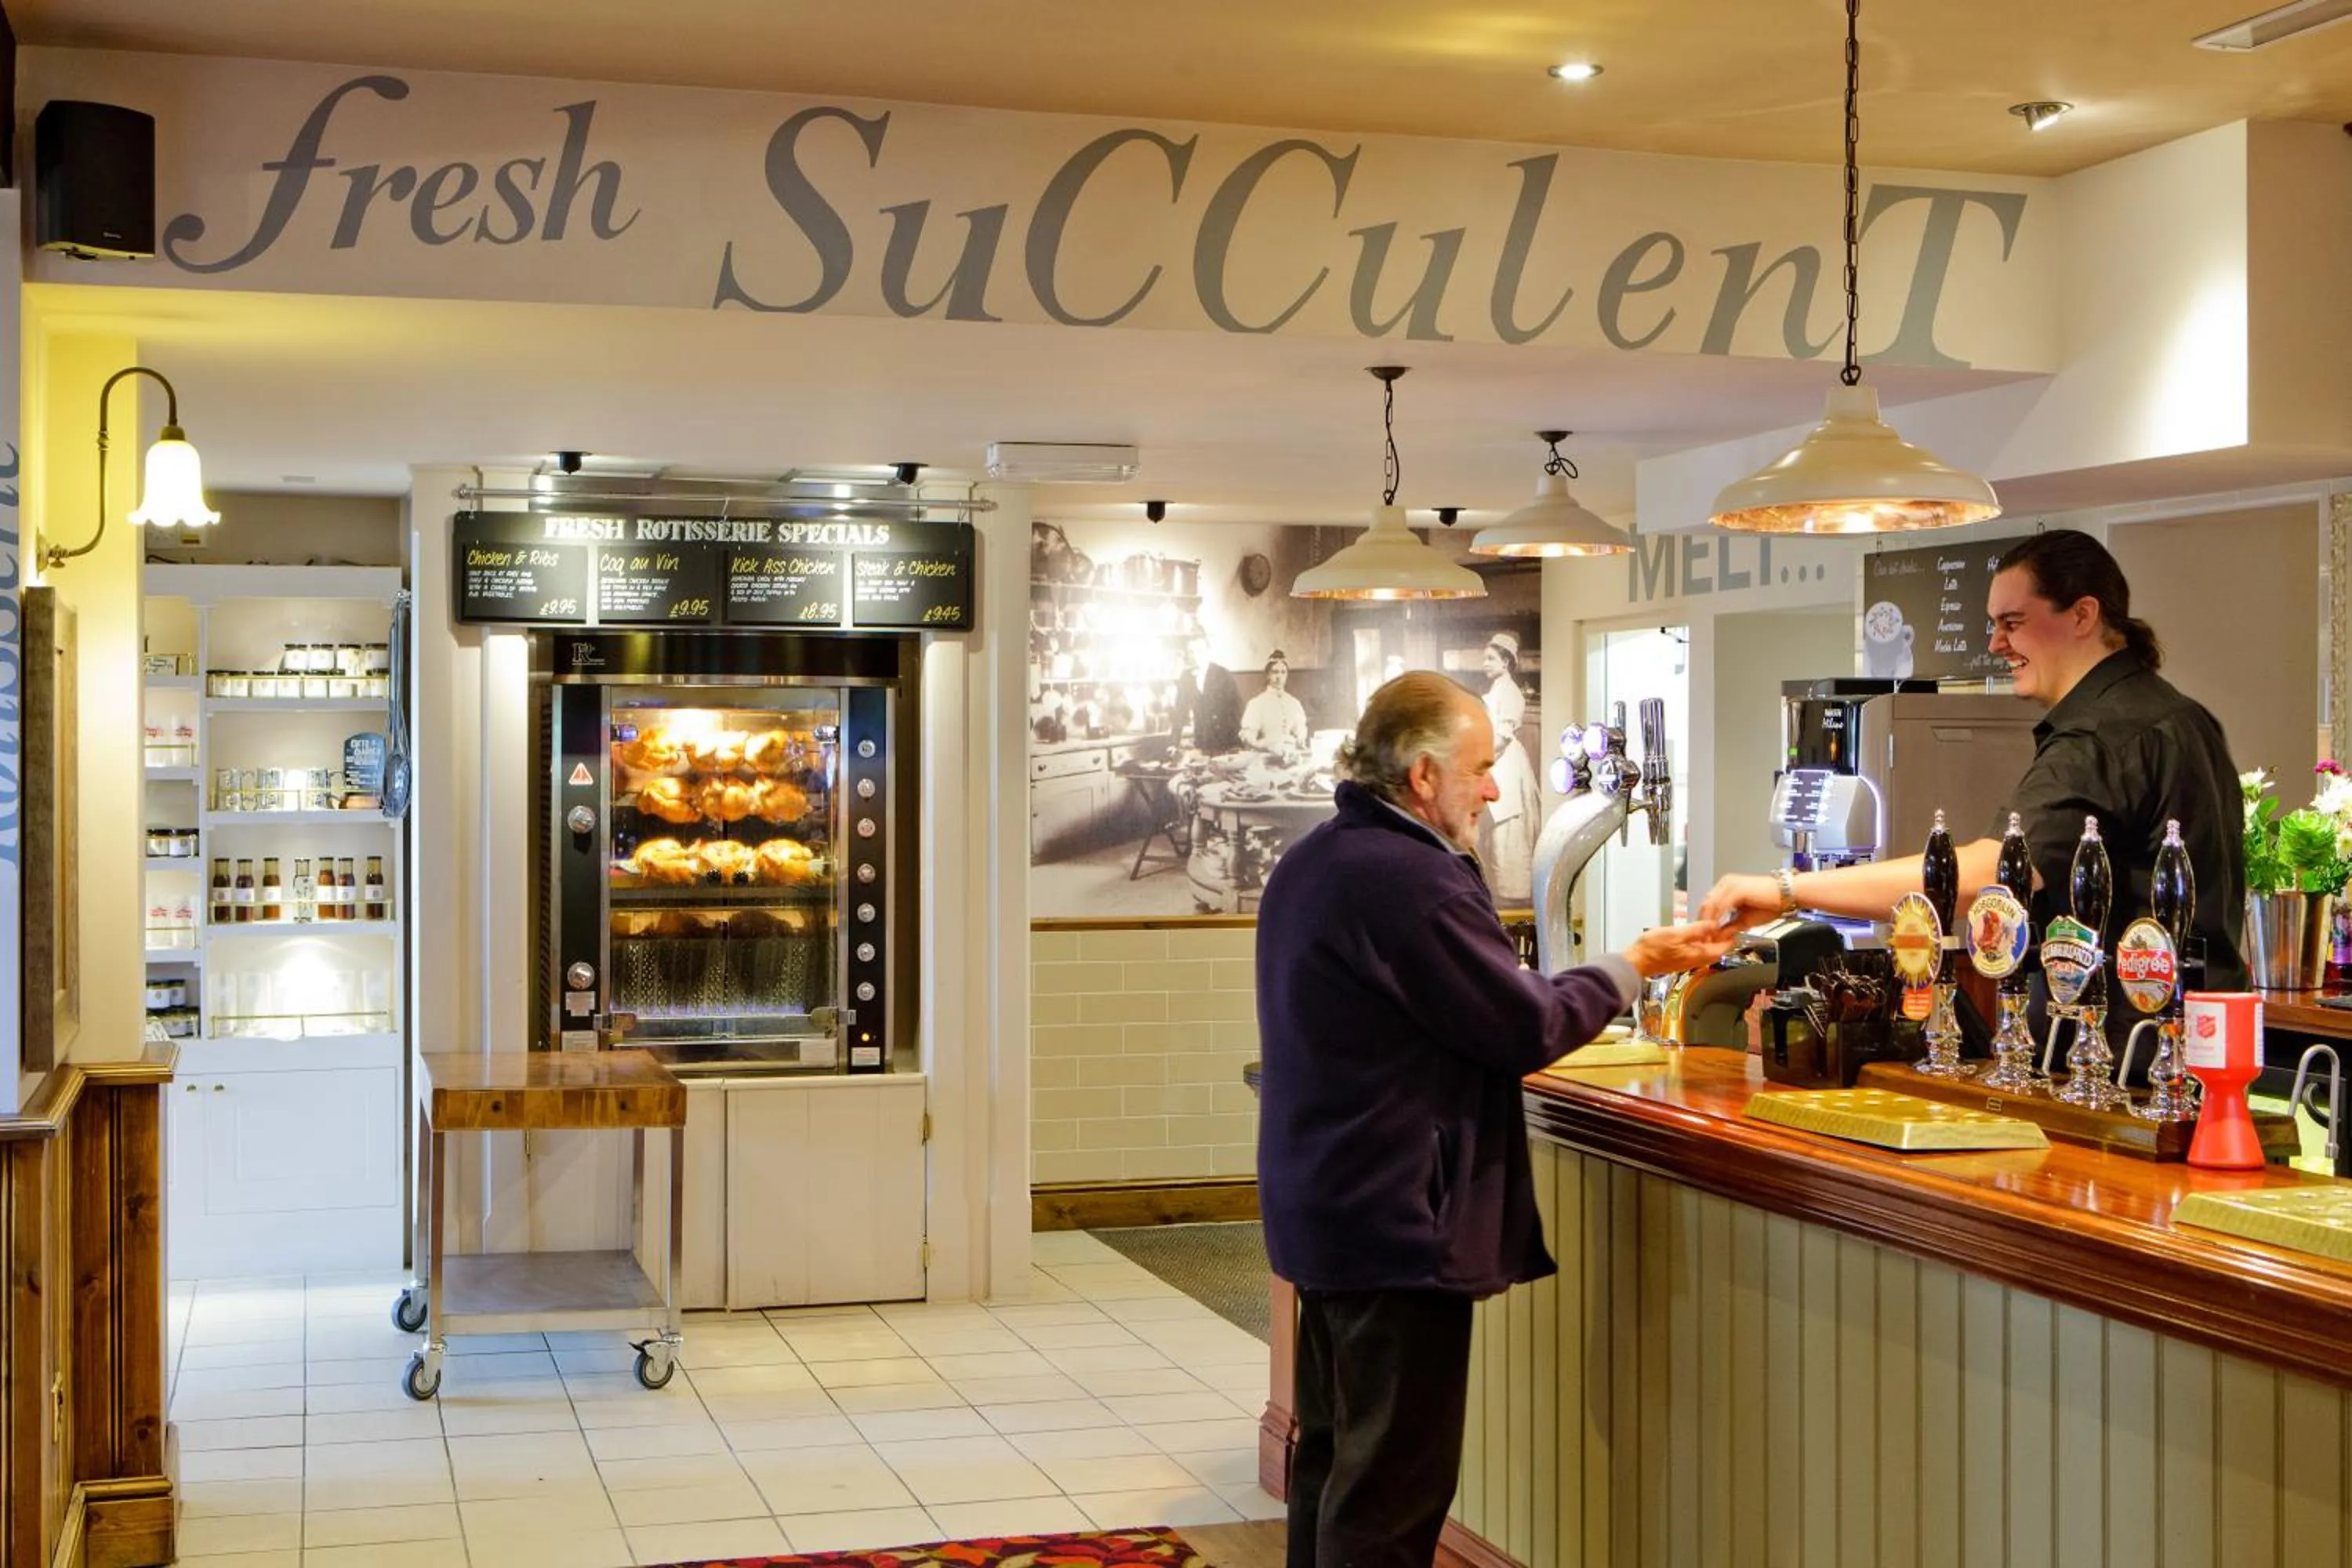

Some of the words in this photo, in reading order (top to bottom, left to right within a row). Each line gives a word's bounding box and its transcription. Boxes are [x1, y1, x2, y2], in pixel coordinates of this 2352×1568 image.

[162, 75, 641, 274] fresh
[713, 106, 2028, 369] SuCCulenT
[543, 517, 626, 540] FRESH
[636, 518, 772, 543] ROTISSERIE
[778, 522, 891, 545] SPECIALS
[467, 550, 511, 567] Chicken
[514, 550, 528, 565] &
[529, 550, 560, 567] Ribs
[601, 553, 626, 576] Coq
[630, 557, 650, 571] au
[656, 553, 680, 571] Vin
[731, 557, 759, 573] Kick
[764, 557, 786, 574] Ass
[788, 557, 837, 575] Chicken
[857, 559, 891, 577] Steak
[893, 561, 906, 576] &
[909, 559, 956, 576] Chicken
[539, 598, 577, 615] £9.95
[669, 598, 710, 618] £9.95
[799, 601, 837, 619] £8.95
